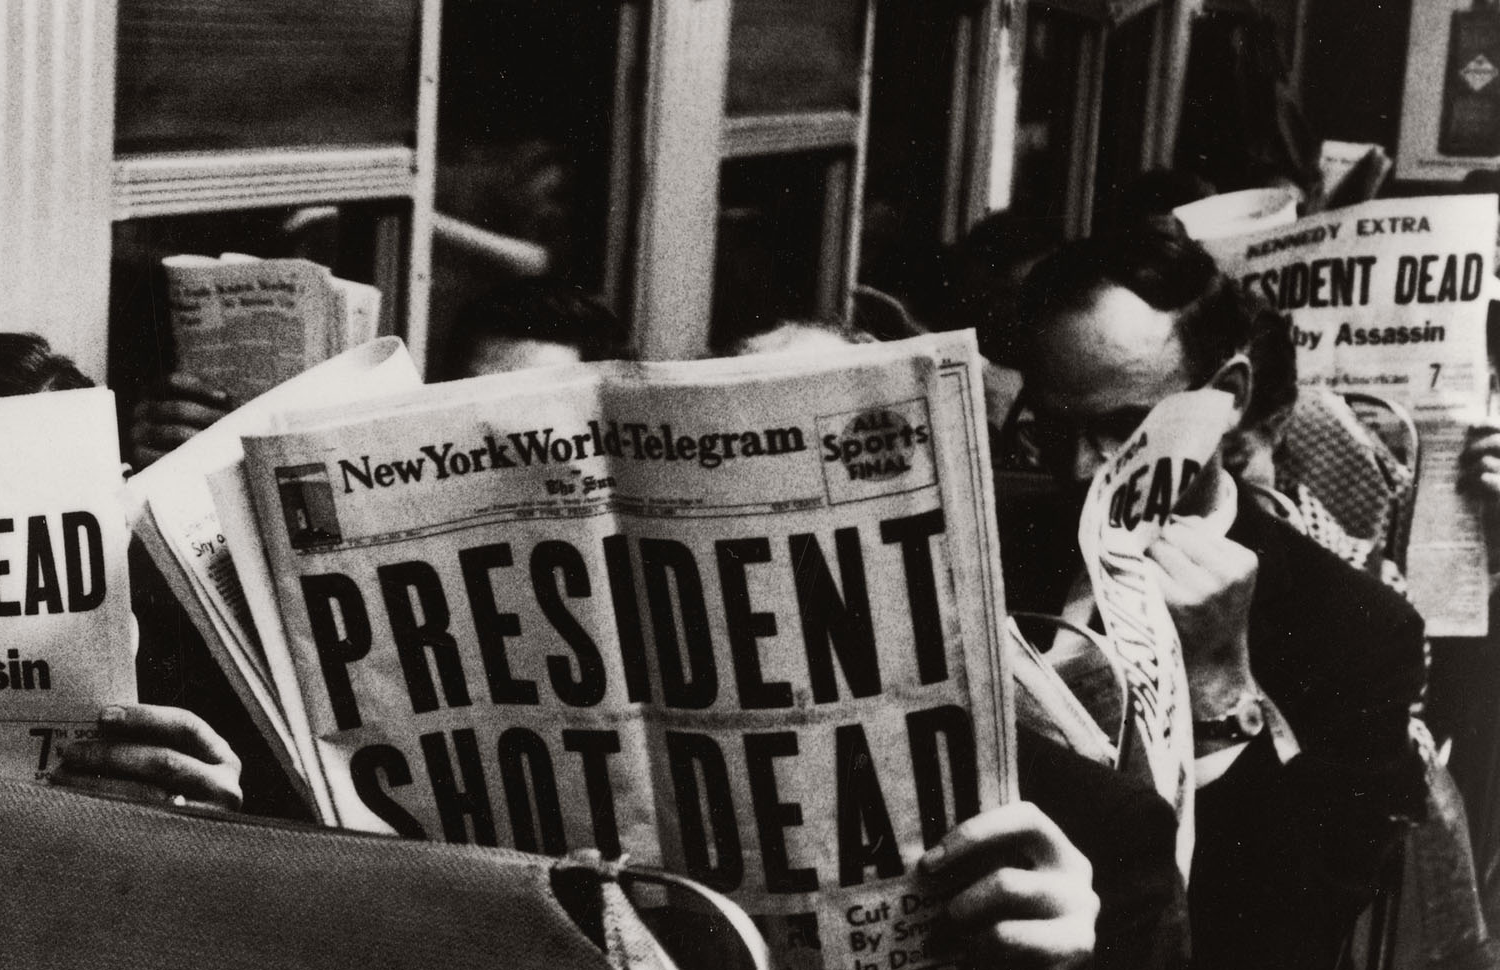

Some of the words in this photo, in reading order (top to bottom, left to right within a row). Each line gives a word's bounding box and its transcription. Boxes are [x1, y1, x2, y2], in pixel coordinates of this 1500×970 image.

[1245, 222, 1343, 260] KENNEDY
[1357, 216, 1432, 237] EXTRA
[1242, 255, 1378, 310] ESIDENT
[1394, 252, 1484, 306] DEAD
[1293, 325, 1323, 351] by
[1334, 319, 1446, 347] Assassin
[1429, 362, 1442, 389] 7
[853, 410, 894, 434] ALL
[822, 424, 929, 463] Sports
[849, 454, 912, 481] FINAL
[300, 508, 949, 731] PRESIDENT
[350, 726, 622, 862] SHOT
[664, 703, 981, 895] DEAD
[846, 901, 891, 927] Cut
[901, 893, 938, 915] Do
[850, 930, 883, 953] By
